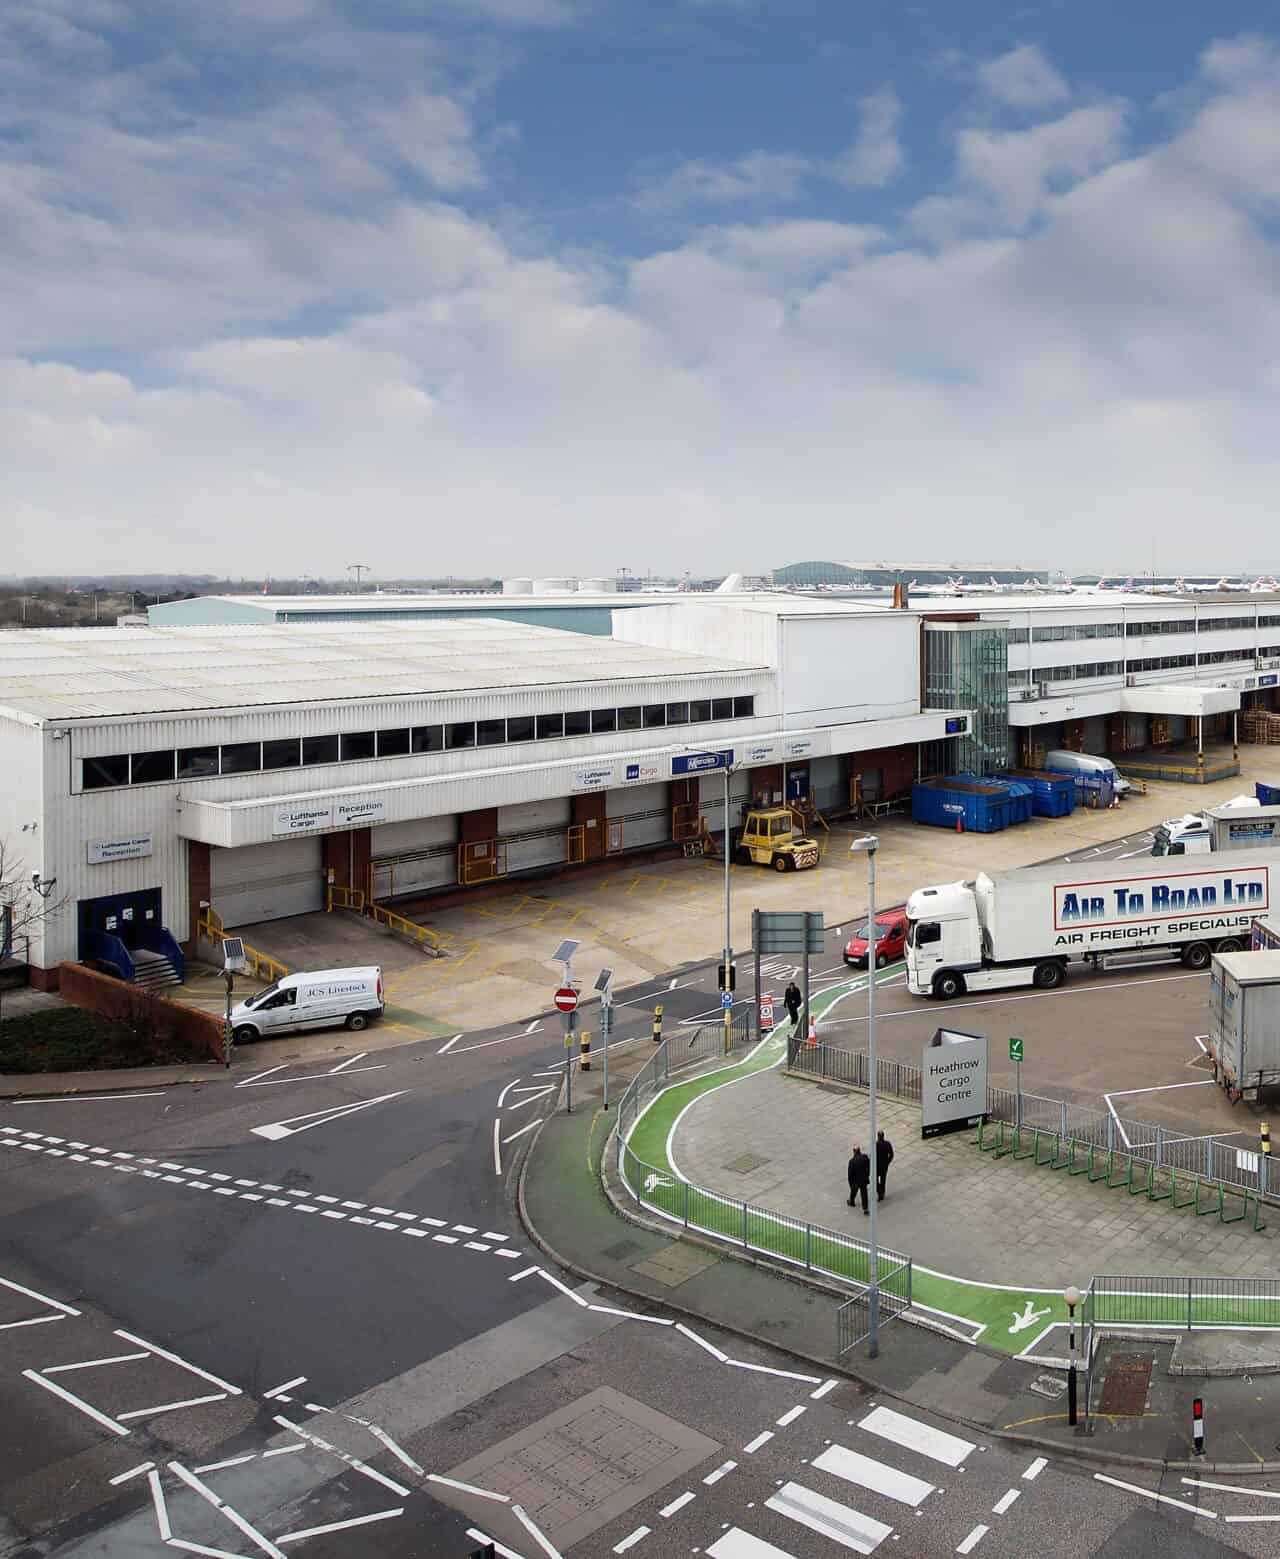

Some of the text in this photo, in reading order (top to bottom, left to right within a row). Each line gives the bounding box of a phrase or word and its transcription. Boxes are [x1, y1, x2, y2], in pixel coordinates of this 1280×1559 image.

[584, 769, 611, 779] Lufthansa
[338, 802, 383, 814] Reception
[290, 809, 329, 821] Lufthansa
[290, 819, 315, 829] Cargo
[1061, 878, 1263, 921] AIR TO ROAD LTD
[1055, 934, 1084, 946] AIR
[1090, 926, 1161, 942] FREIGHT
[328, 983, 367, 994] Livestock
[930, 1060, 980, 1076] Heathrow
[939, 1076, 970, 1088] Cargo
[937, 1089, 972, 1103] Centre
